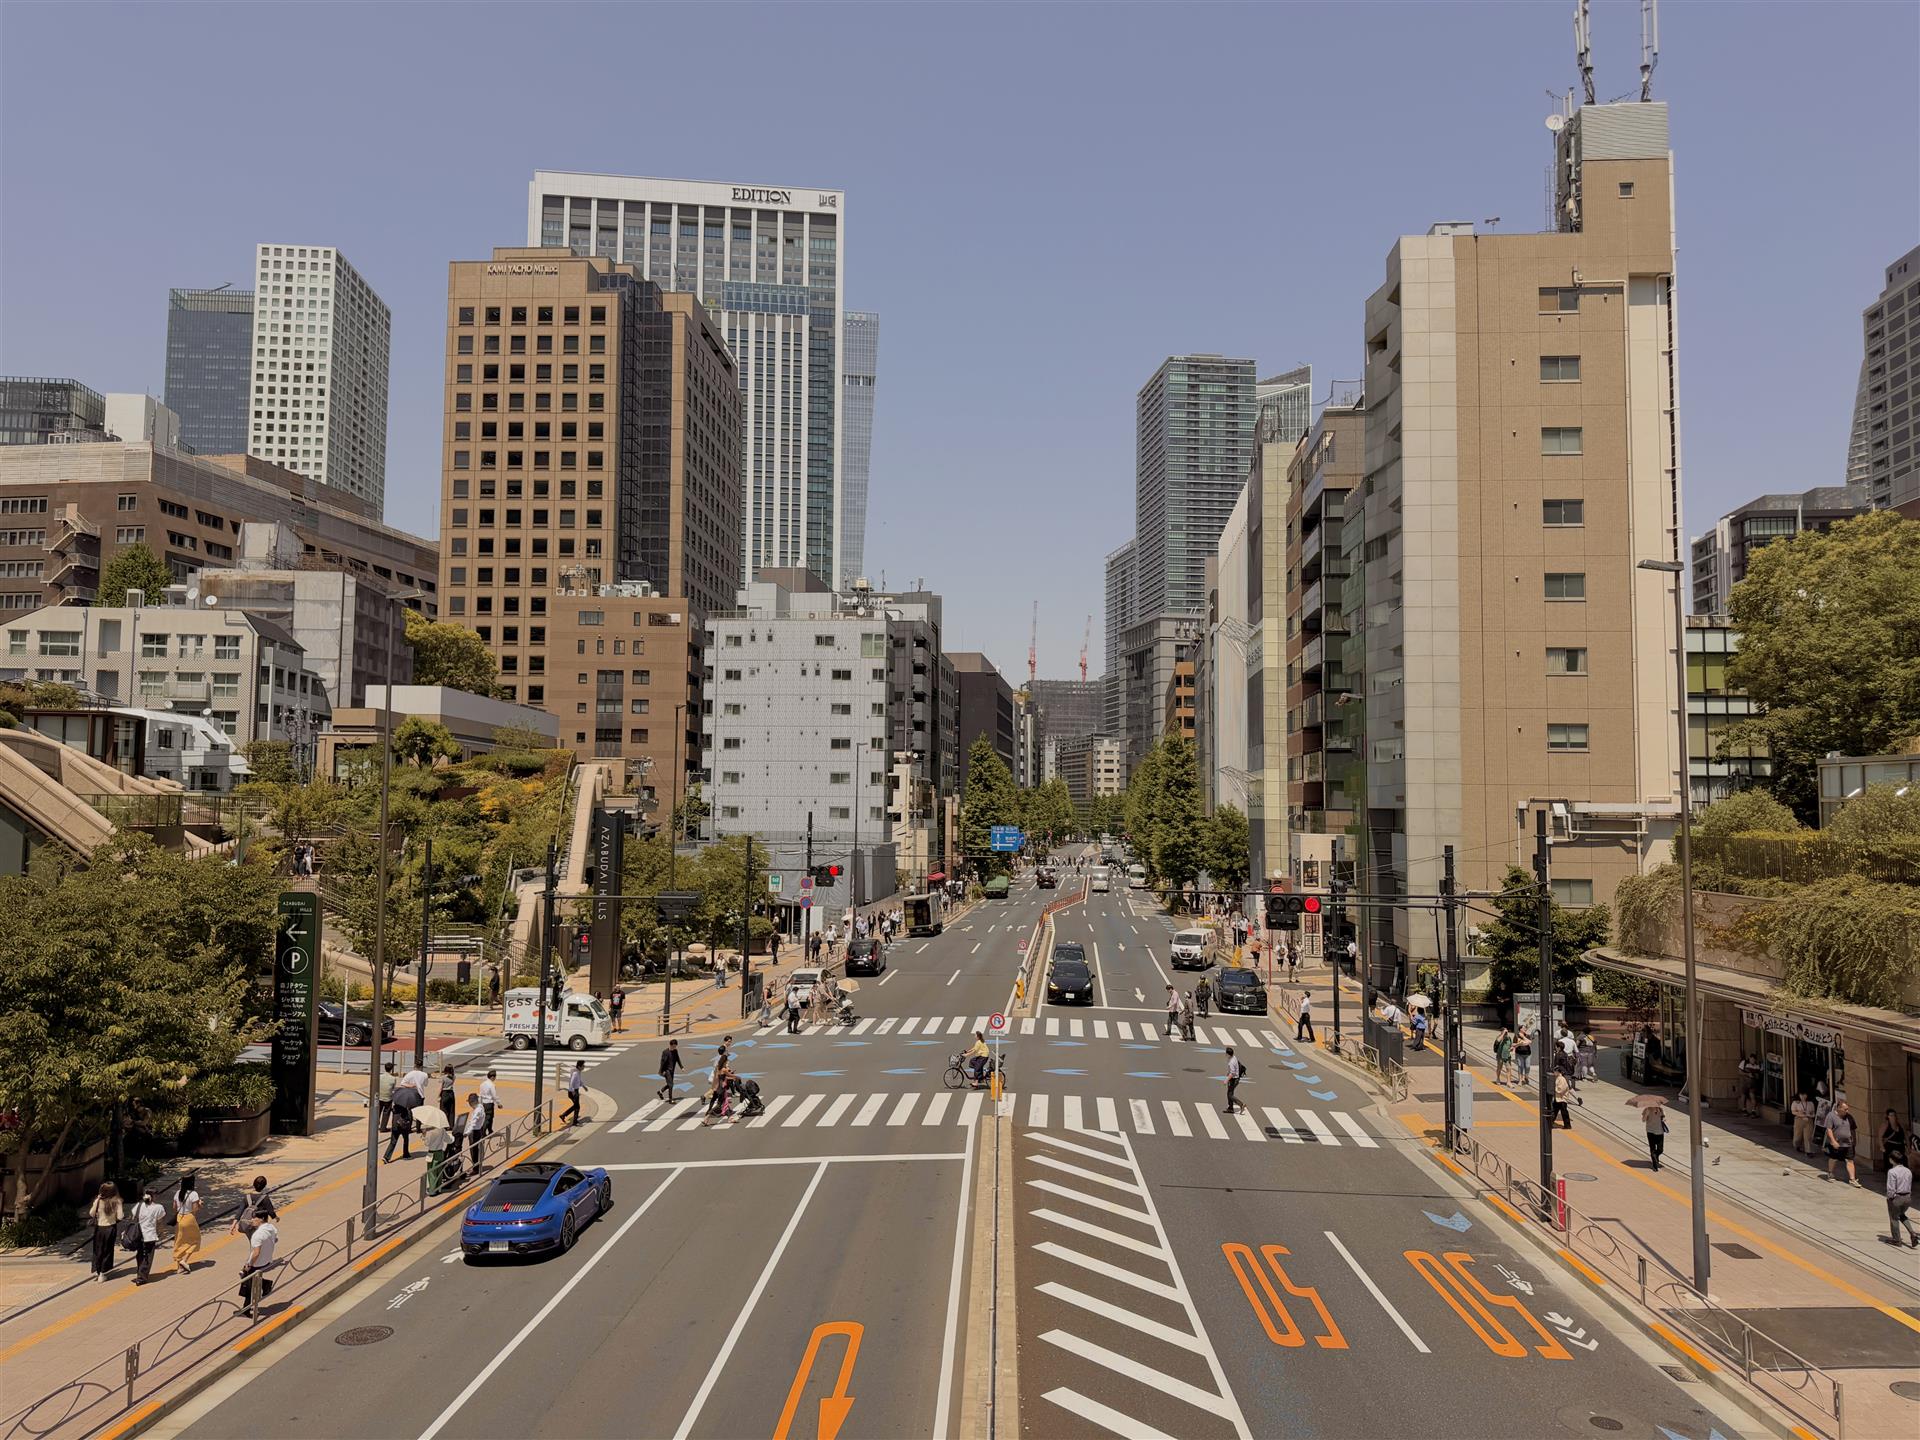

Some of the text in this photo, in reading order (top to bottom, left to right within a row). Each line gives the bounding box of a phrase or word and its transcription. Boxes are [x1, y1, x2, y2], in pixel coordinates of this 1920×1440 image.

[732, 187, 791, 204] EDITION
[598, 826, 611, 920] AZABUDAI HLLS
[291, 951, 301, 969] P
